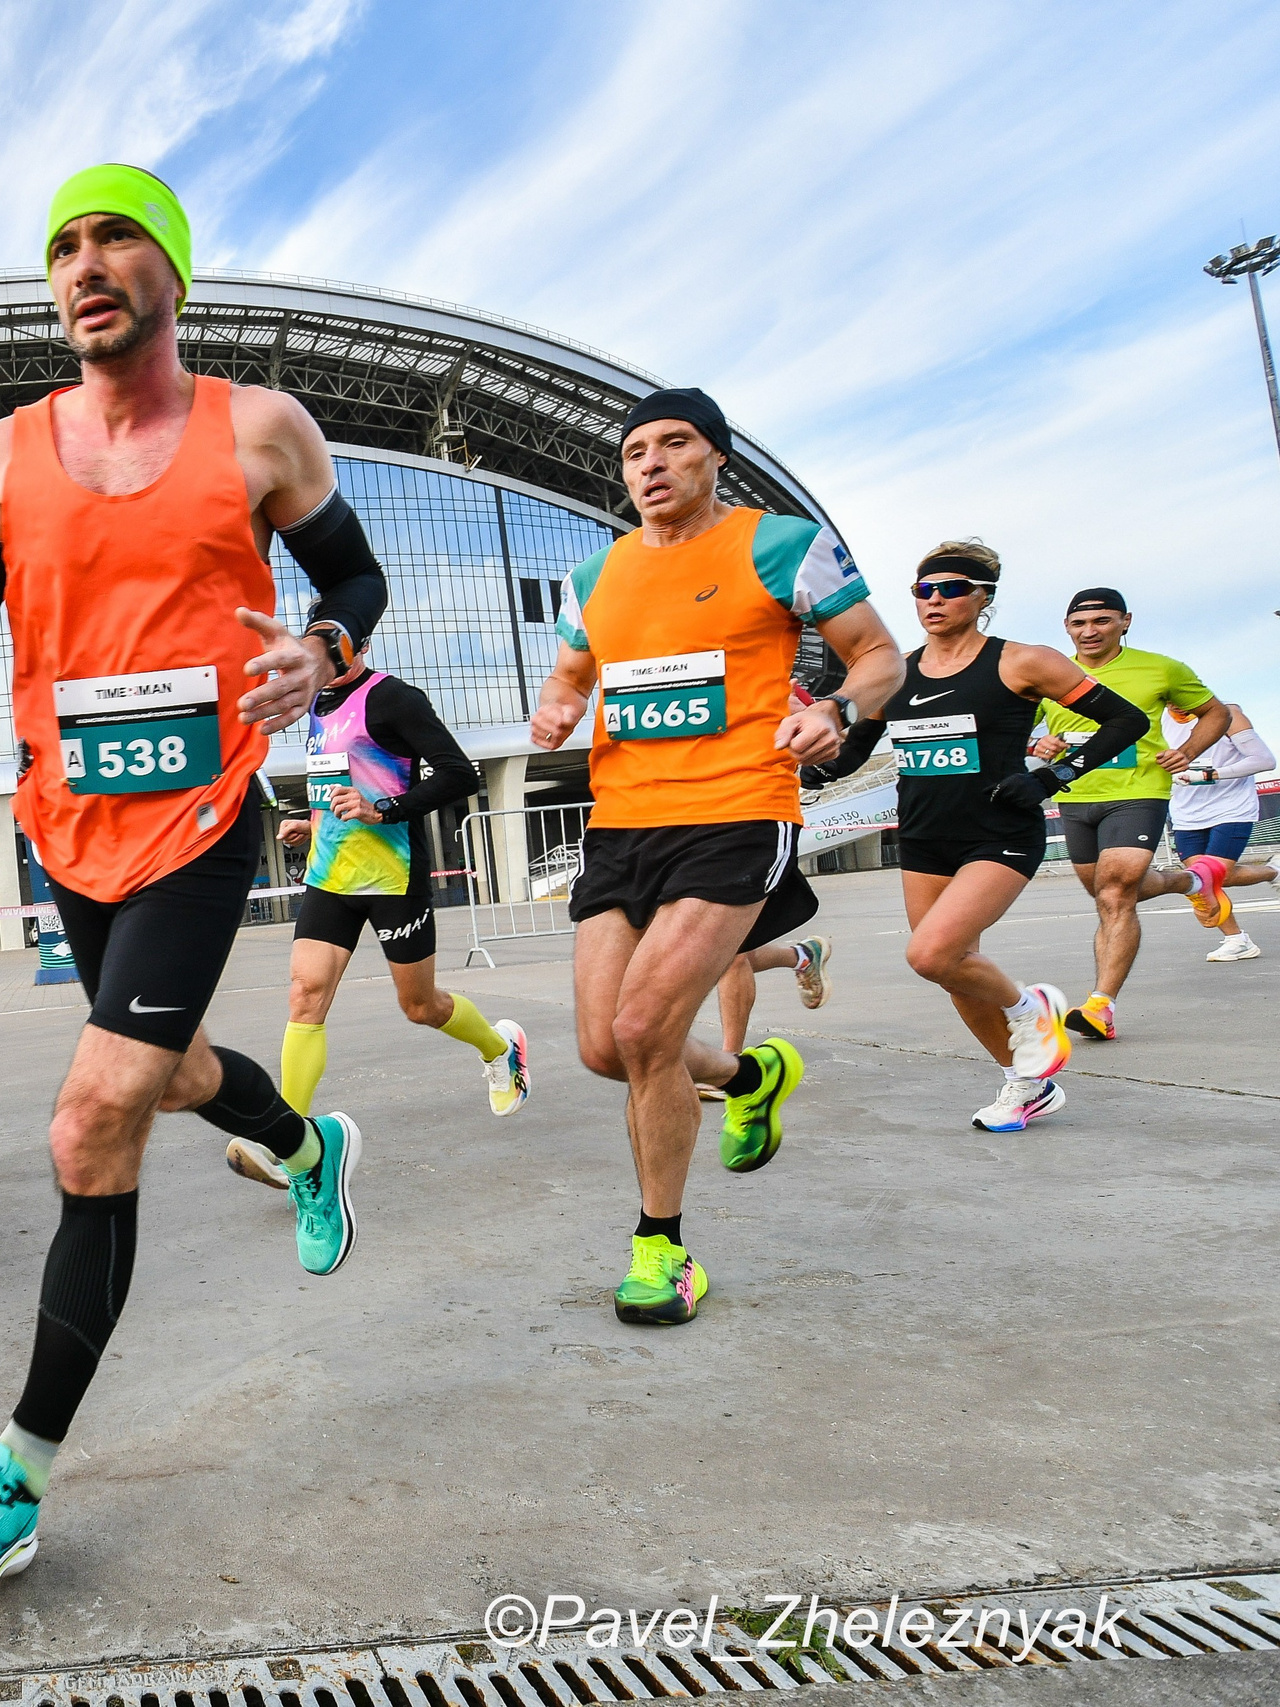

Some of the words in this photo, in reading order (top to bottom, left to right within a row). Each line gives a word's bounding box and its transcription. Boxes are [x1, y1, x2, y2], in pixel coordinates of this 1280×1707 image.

[621, 698, 710, 730] 1665
[98, 735, 188, 778] 538
[905, 747, 968, 768] 1768
